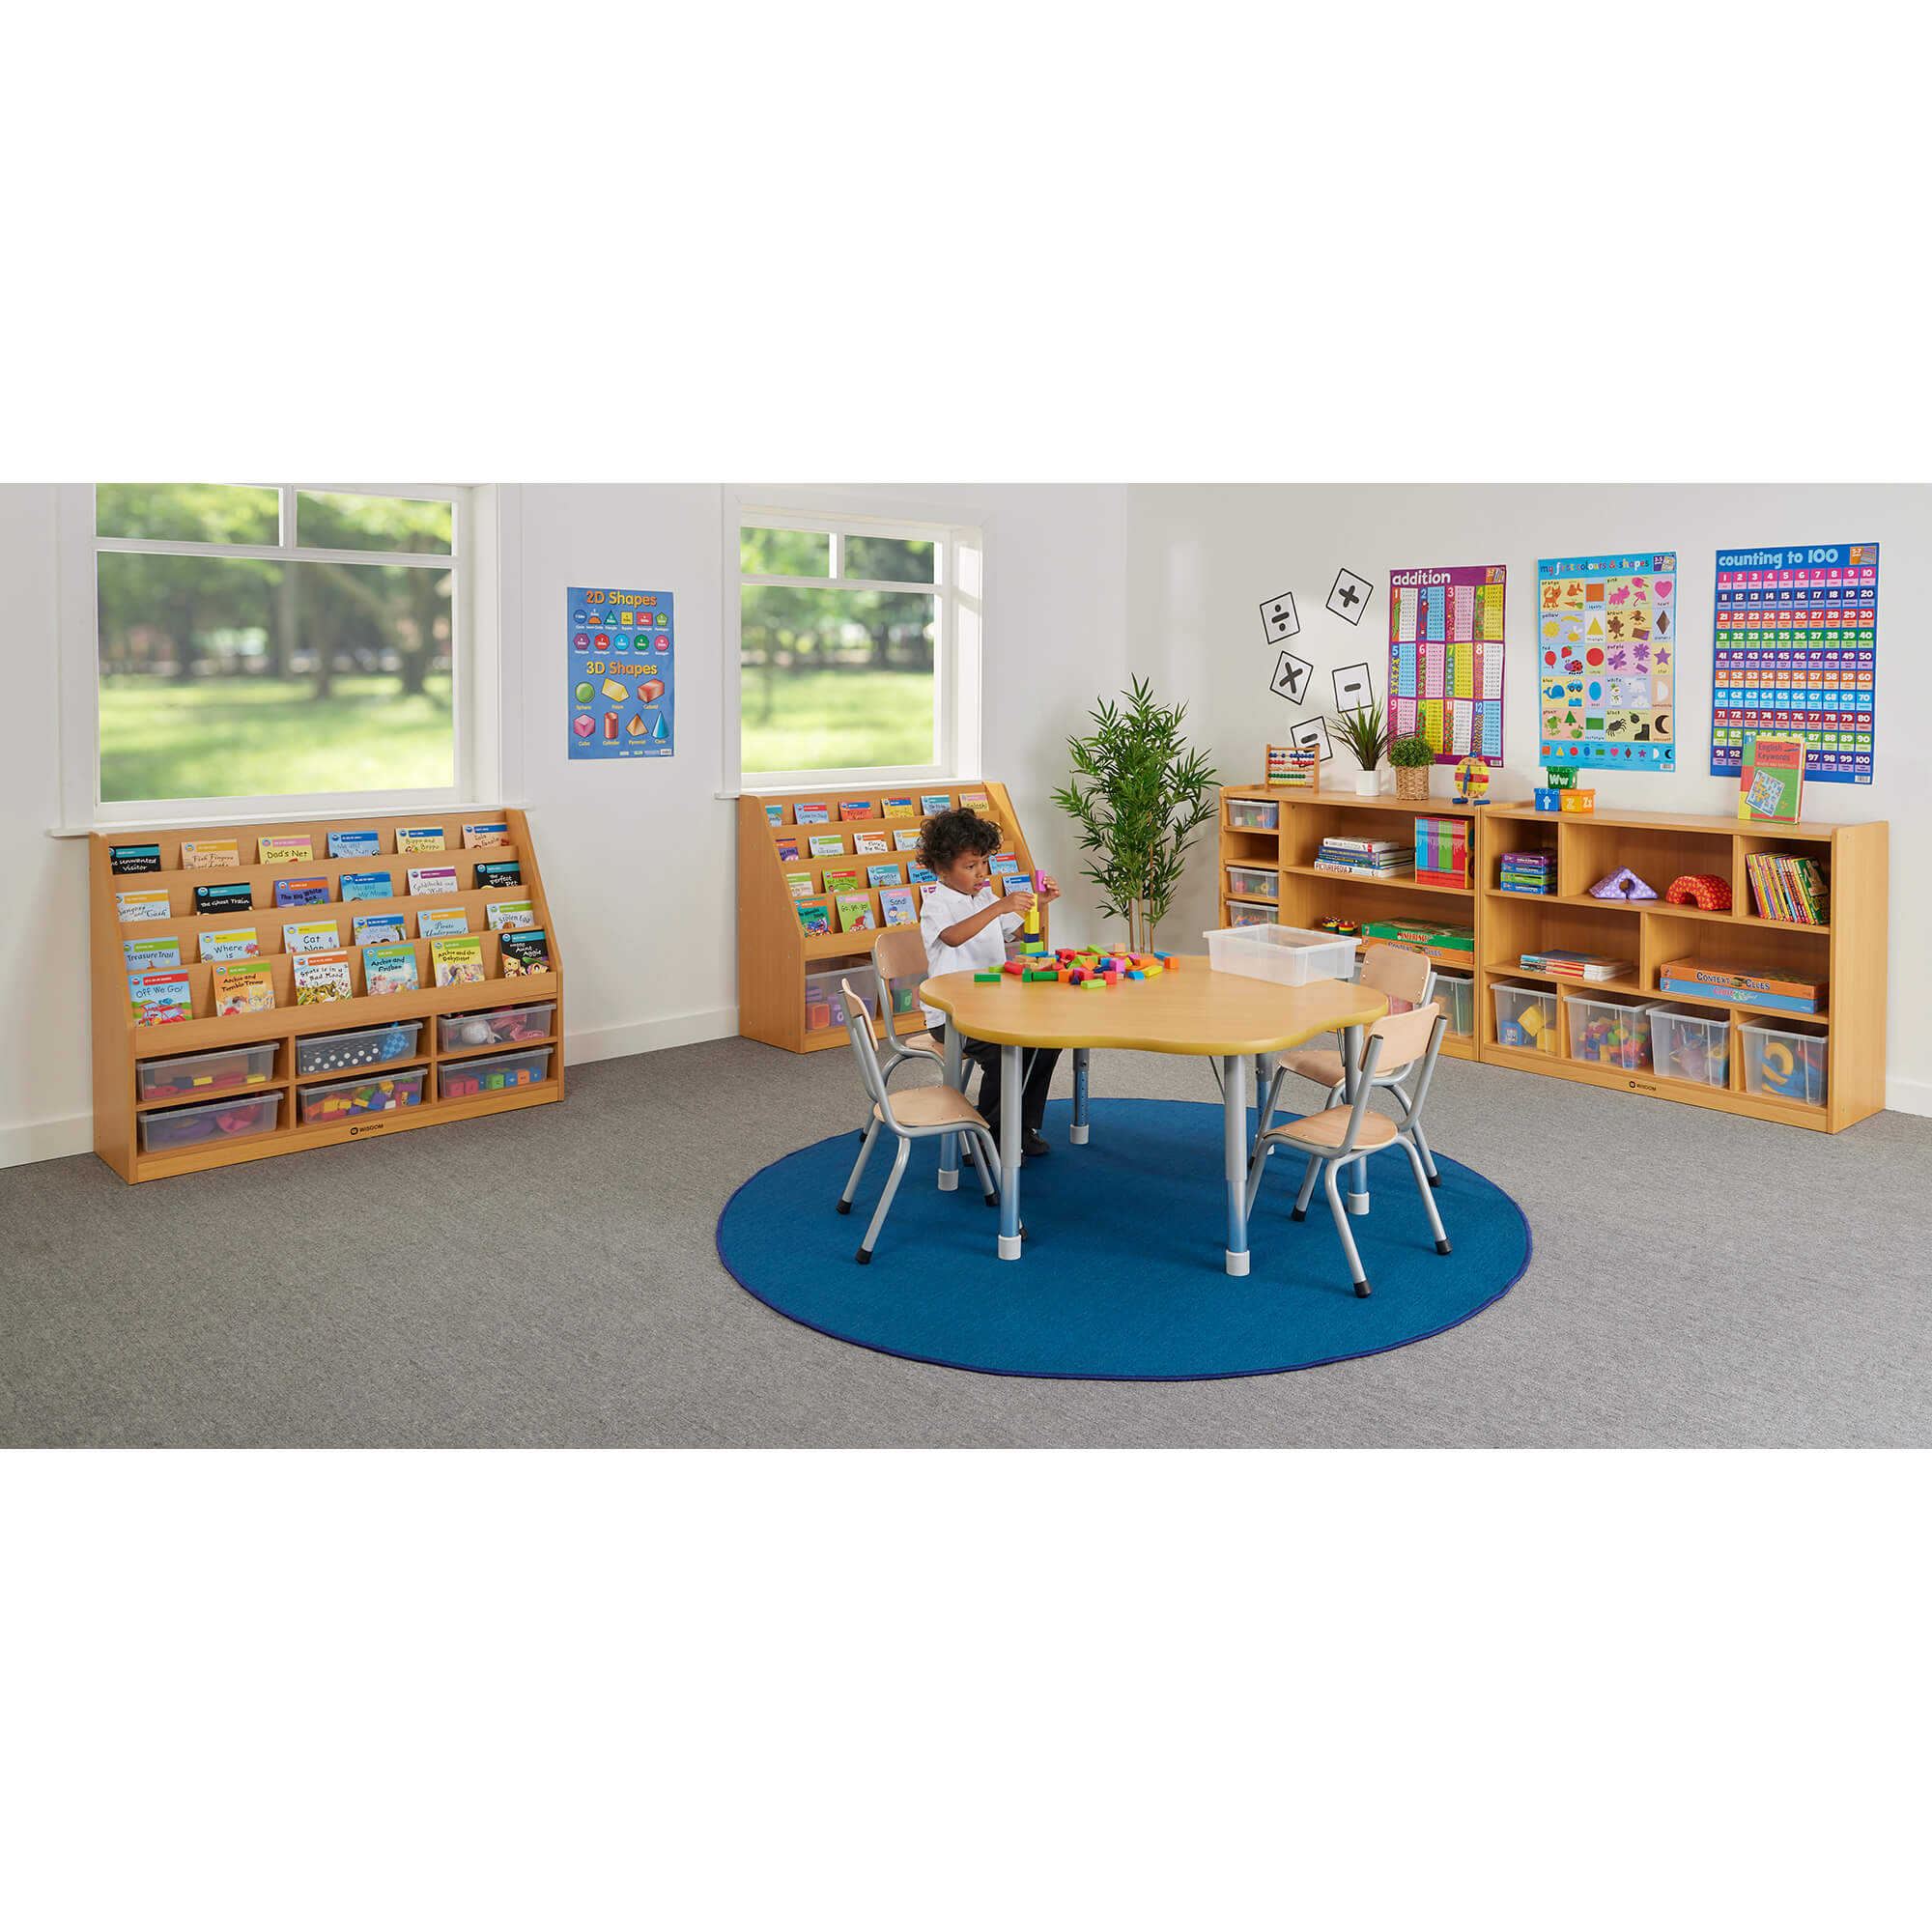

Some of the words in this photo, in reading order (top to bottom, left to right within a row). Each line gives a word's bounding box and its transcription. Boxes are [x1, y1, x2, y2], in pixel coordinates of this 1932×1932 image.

[1719, 551, 1783, 569] counting
[1787, 551, 1803, 564] to
[1808, 549, 1838, 564] 100
[1541, 565, 1553, 576] my
[1555, 562, 1575, 576] first
[1577, 560, 1606, 571] colours
[1619, 558, 1649, 571] shapes
[1392, 570, 1451, 585] addition
[1448, 587, 1455, 597] 3
[585, 590, 605, 604] 2D
[609, 591, 657, 609] Shapes
[1392, 645, 1398, 655] 5
[1419, 644, 1425, 655] 6
[1476, 644, 1482, 655] 8
[586, 662, 606, 675] 3D
[609, 661, 657, 678] Shapes
[1391, 699, 1397, 710] 9
[1476, 702, 1483, 712] 12
[1549, 774, 1569, 786] Ww
[267, 850, 289, 859] Dad's
[303, 935, 320, 945] Cat
[213, 945, 242, 954] Where
[128, 952, 157, 962] Treasure
[136, 987, 151, 999] Off
[154, 985, 166, 994] We
[167, 984, 184, 993] Go!
